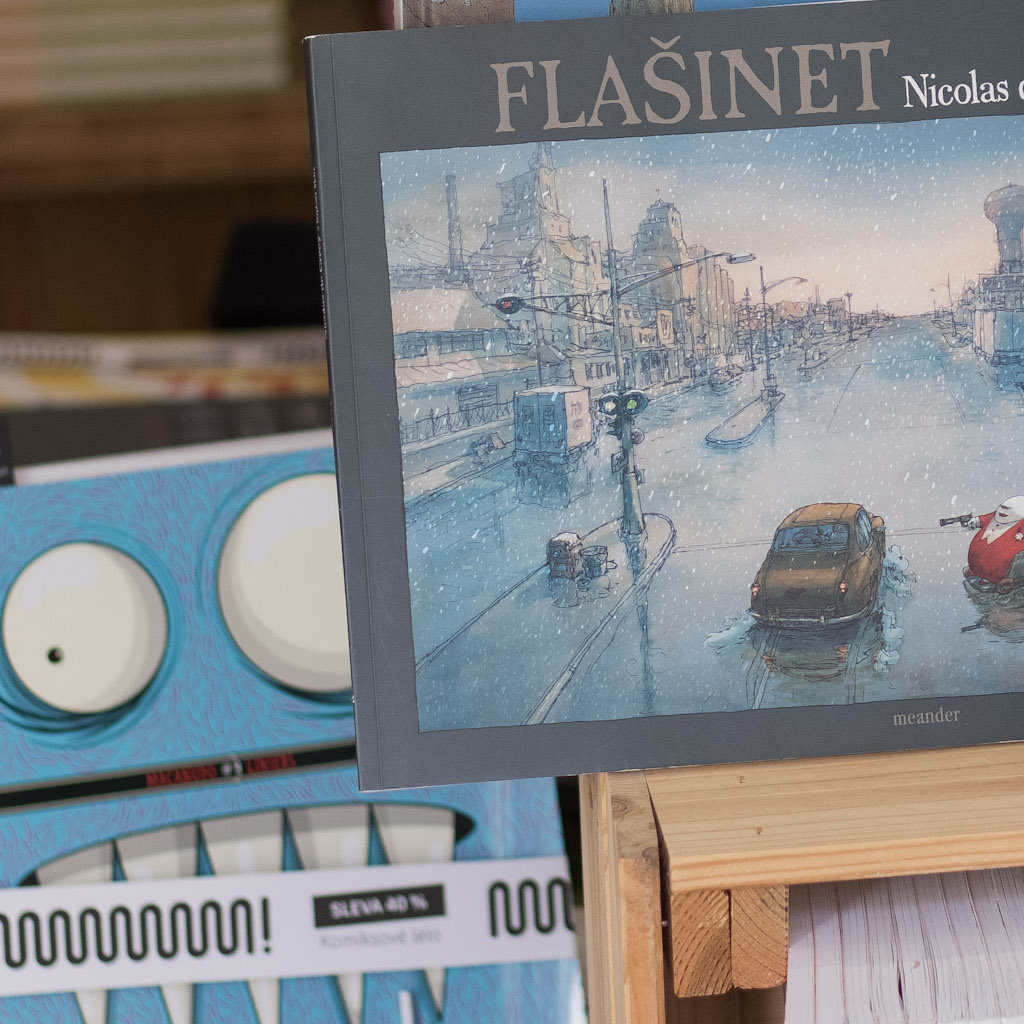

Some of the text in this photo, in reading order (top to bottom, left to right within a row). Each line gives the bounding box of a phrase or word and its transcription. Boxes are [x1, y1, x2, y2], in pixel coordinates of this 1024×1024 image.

[490, 35, 891, 133] FLAŠINET
[902, 72, 1009, 109] Nicolas
[893, 707, 960, 726] meander
[329, 893, 430, 920] SLEVA 40 %
